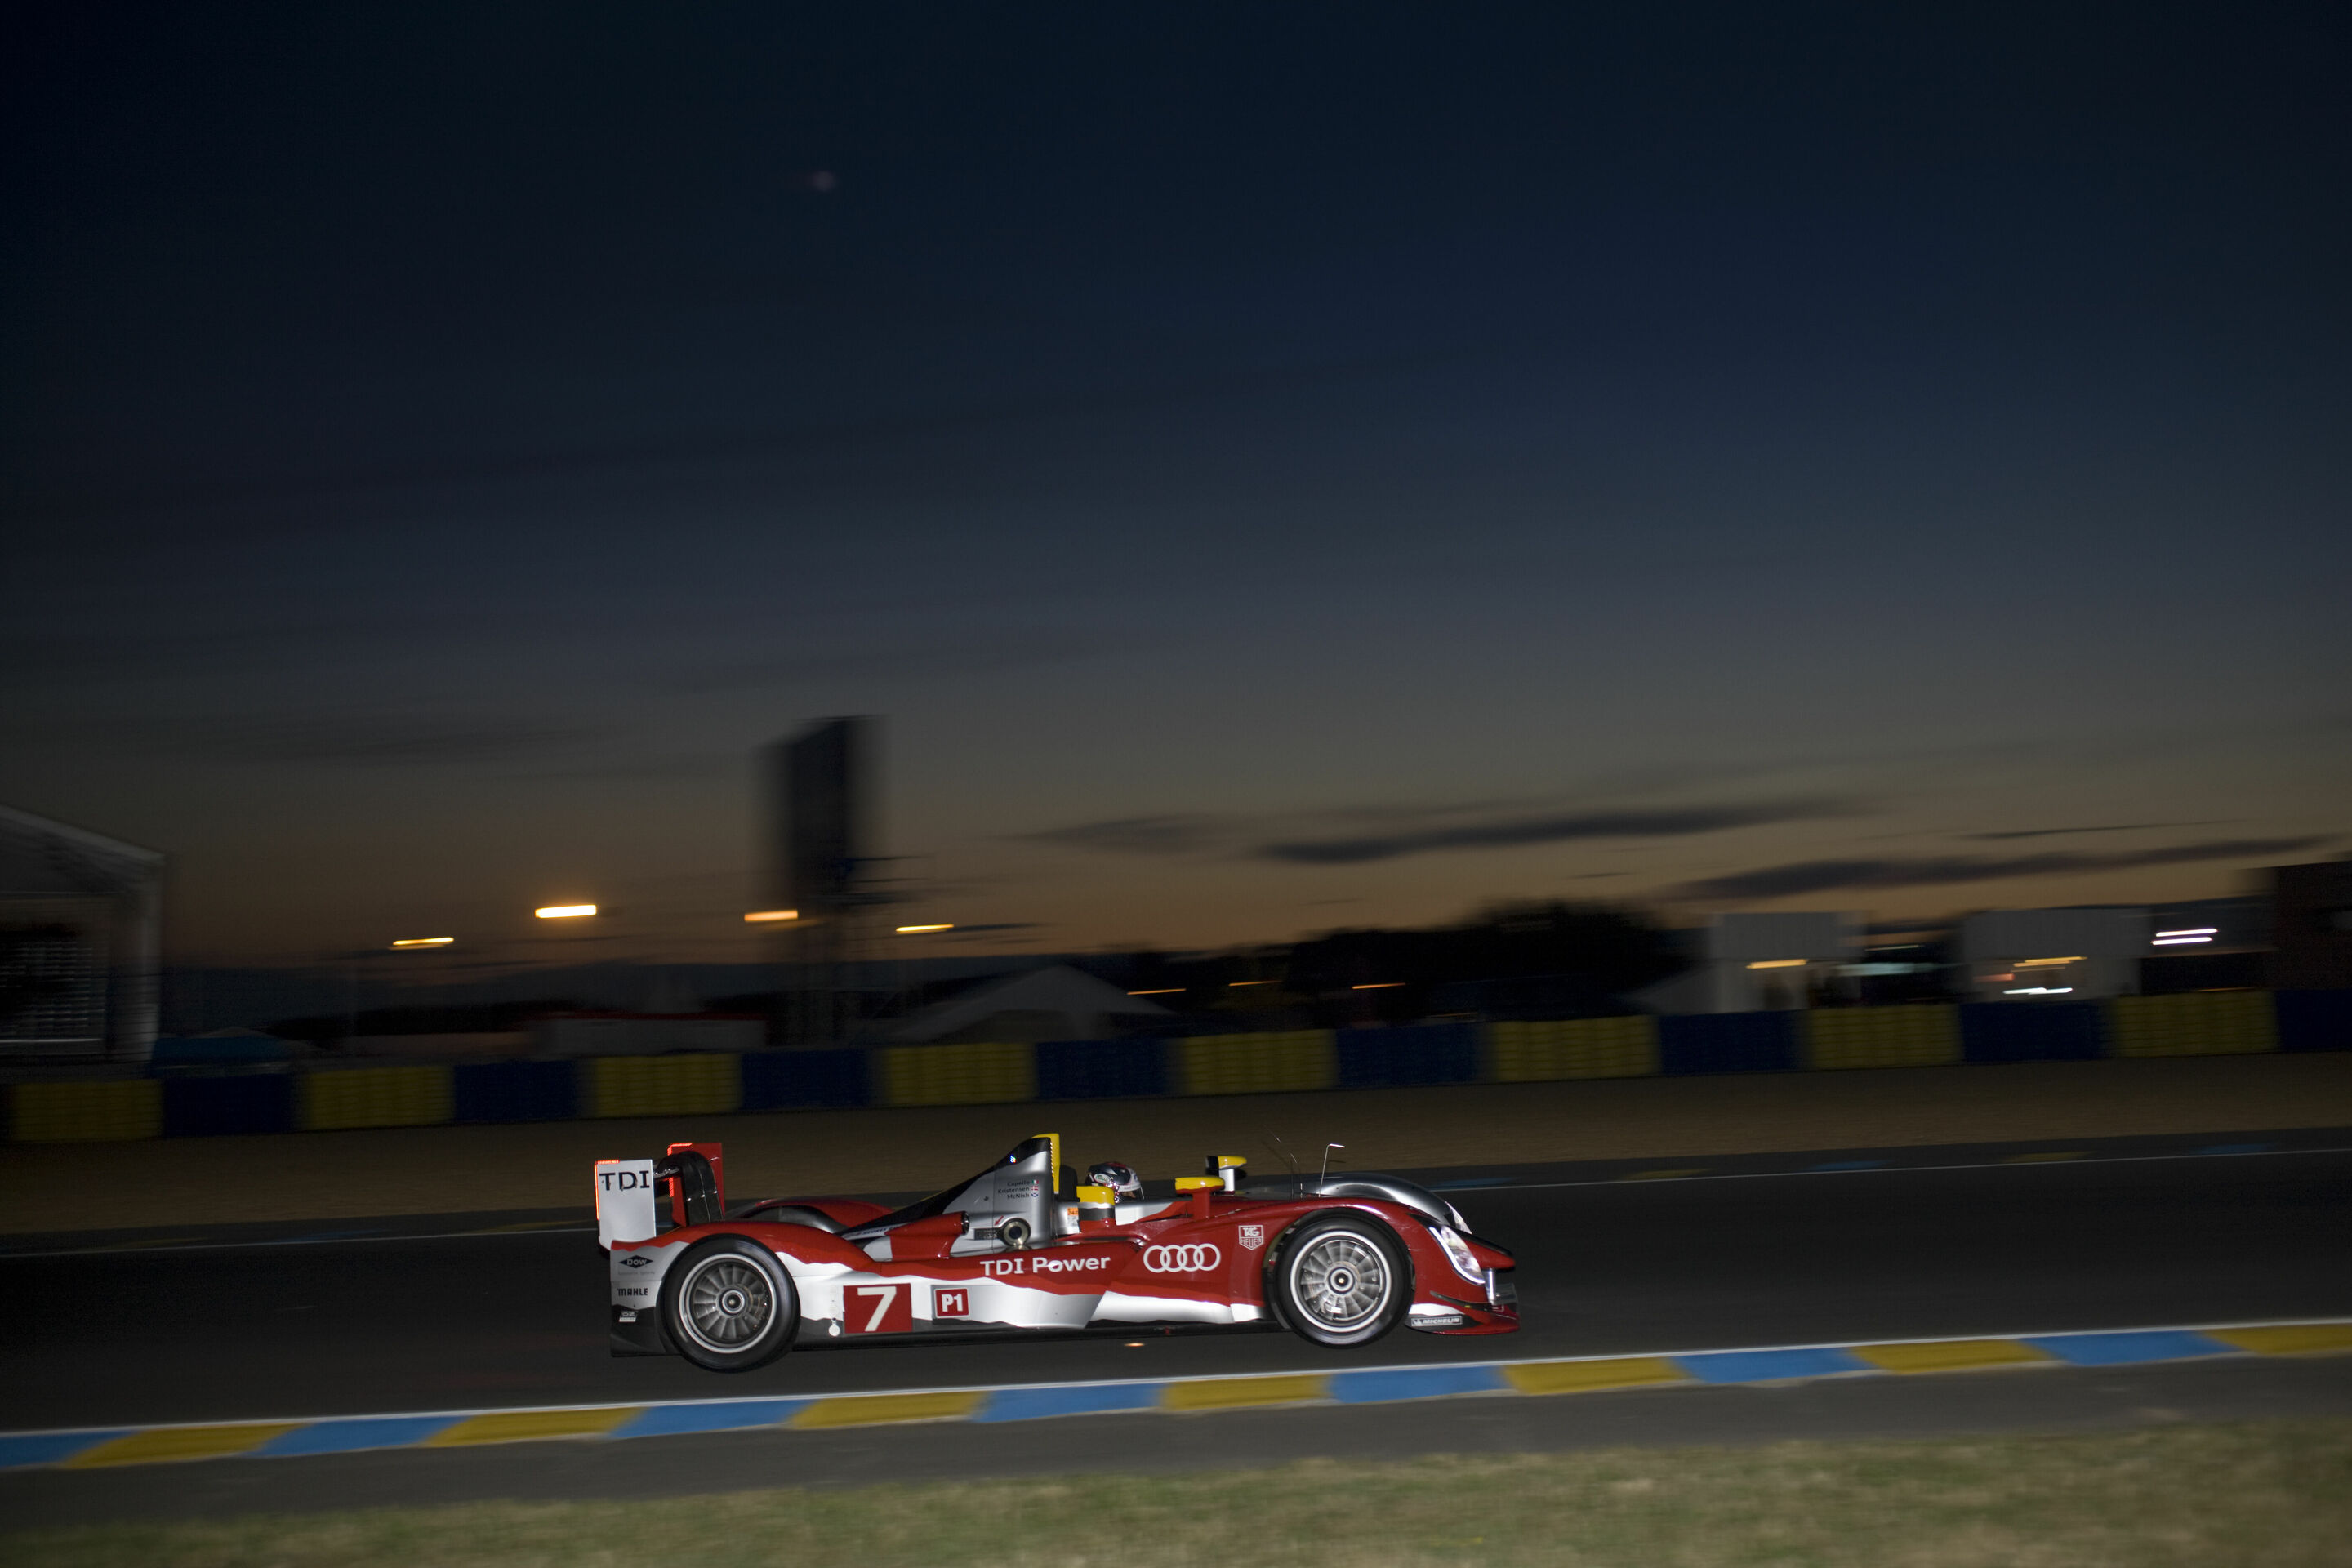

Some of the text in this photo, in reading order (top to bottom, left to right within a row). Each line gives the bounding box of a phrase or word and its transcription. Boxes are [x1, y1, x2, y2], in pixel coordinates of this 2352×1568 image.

[599, 1170, 649, 1191] TDI
[980, 1257, 1111, 1276] TDI Power
[617, 1288, 648, 1296] MAHLE
[858, 1286, 897, 1331] 7
[941, 1294, 963, 1312] P1
